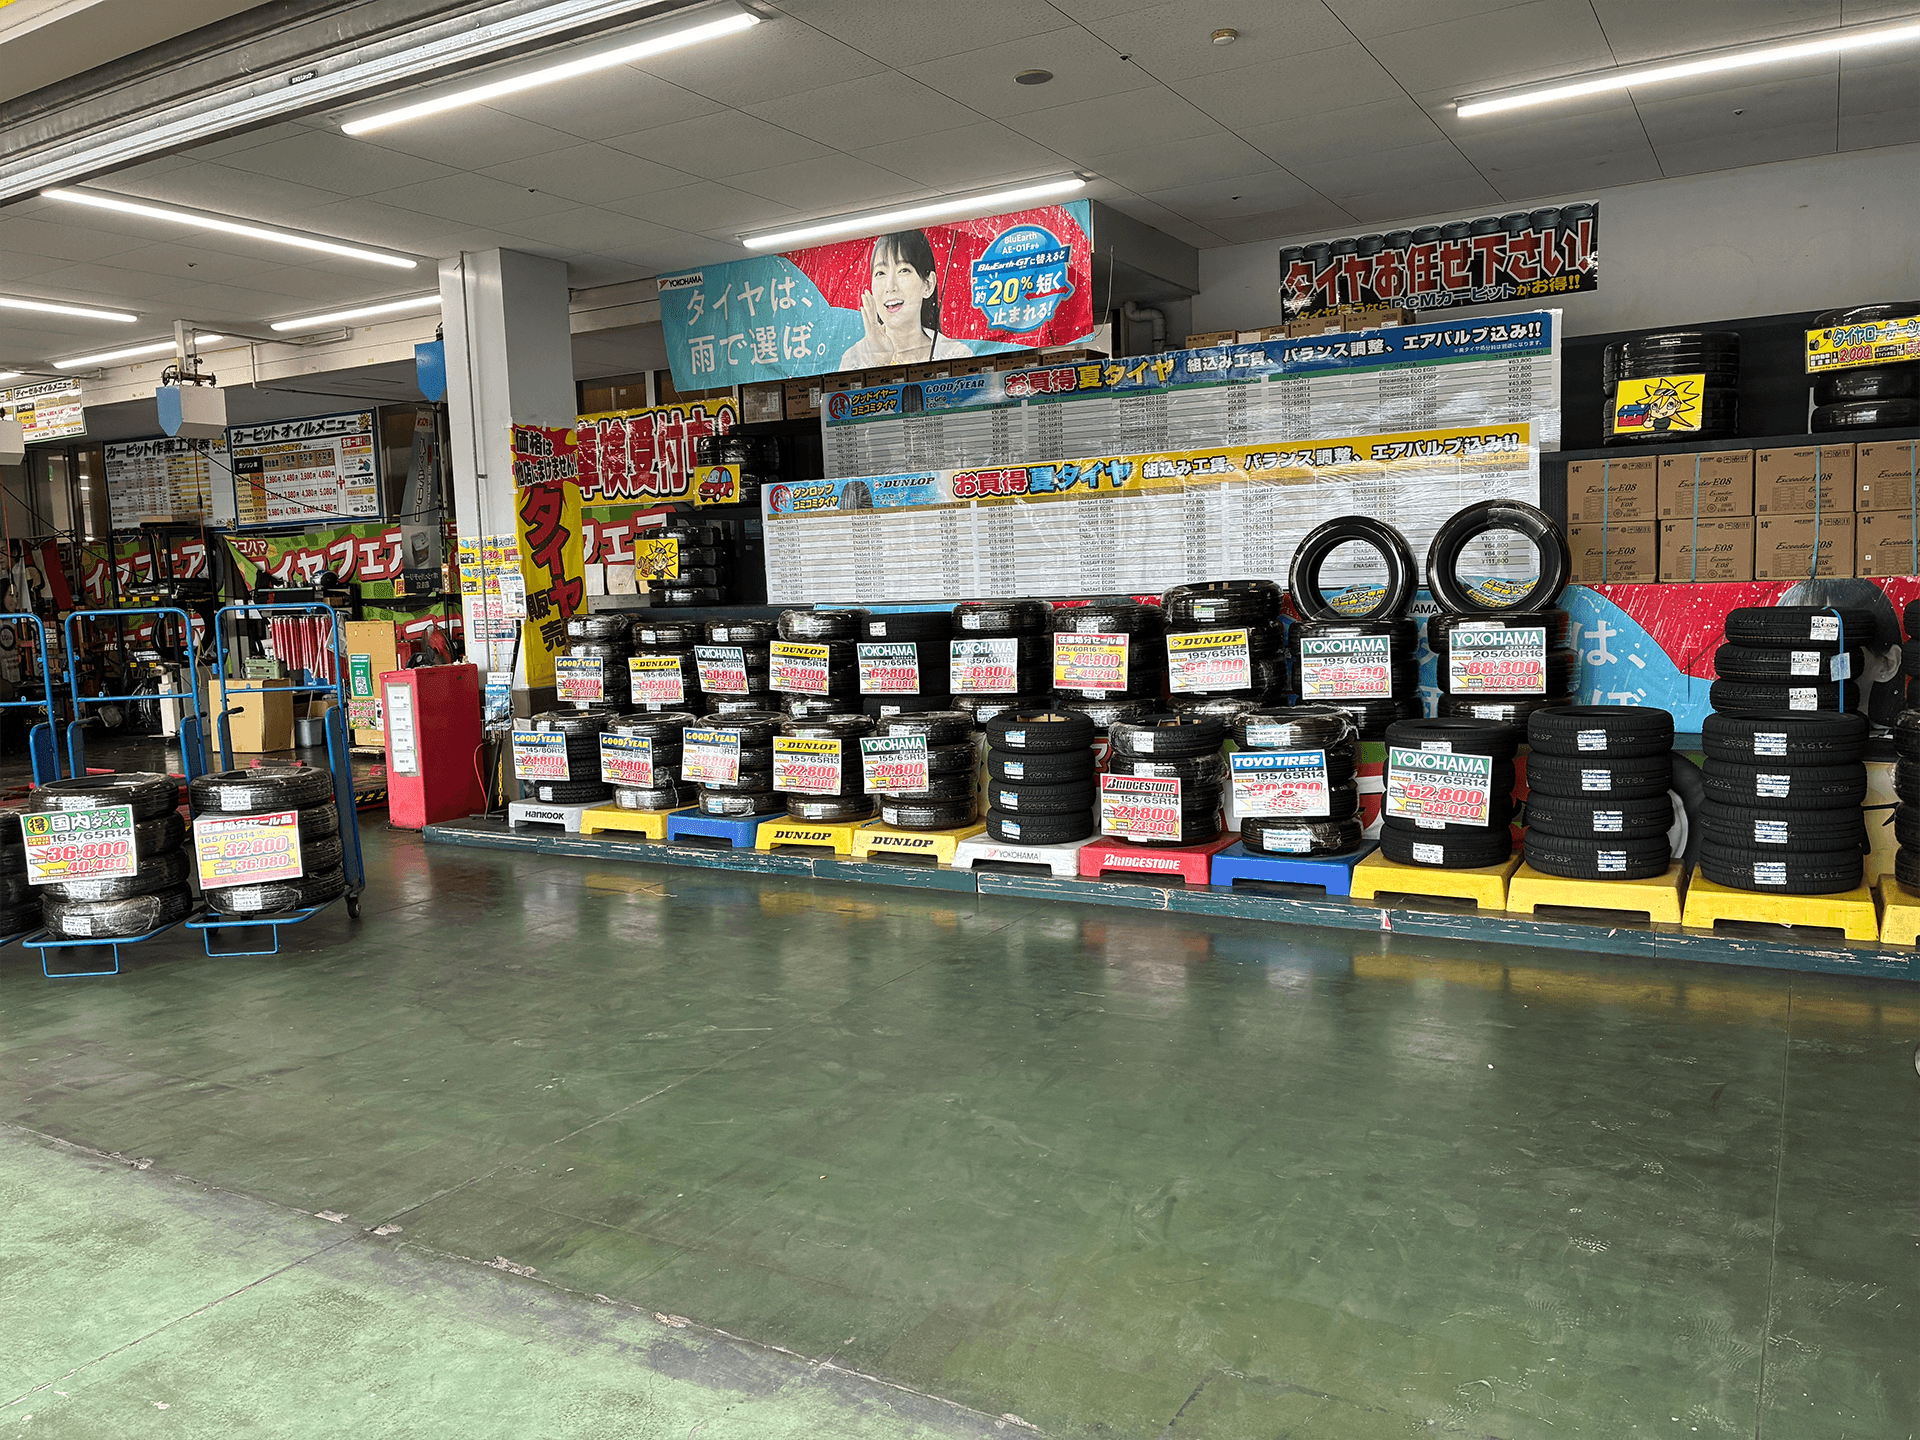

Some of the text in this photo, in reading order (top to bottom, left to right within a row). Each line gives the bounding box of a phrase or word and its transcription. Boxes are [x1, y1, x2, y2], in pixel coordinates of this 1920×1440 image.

[1004, 232, 1037, 244] BluEarth
[669, 275, 702, 288] YOKOHAMA
[687, 276, 812, 326] タイヤは、
[991, 301, 1053, 326] 止まれる!
[688, 321, 826, 375] 雨で選ぼ。
[851, 389, 898, 405] グッドイヤー
[851, 400, 898, 417] コミコミタイヤ
[280, 420, 357, 438] オイルメニュー
[515, 429, 553, 458] 価格は
[515, 454, 579, 488] 他店にまけません!
[884, 477, 935, 489] DUNLOP
[954, 460, 1131, 498] お買得夏タイヤ
[1713, 477, 1732, 486] E08
[793, 484, 834, 499] ダンロップ
[1618, 483, 1637, 492] E08
[793, 496, 839, 510] コミコミタイヤ
[520, 484, 583, 617] タイヤ
[1617, 547, 1636, 555] E08
[1714, 544, 1733, 552] E08
[1411, 604, 1439, 614] AMA
[526, 588, 567, 652] 販売
[1057, 635, 1125, 645] 在庫処分セール品
[1183, 634, 1243, 647] DUNLOP
[1454, 631, 1539, 647] YOKOHAMA
[782, 646, 826, 656] DUNLOP
[860, 645, 914, 656] YOKOHAMA
[953, 641, 1013, 655] YOKOHAMA
[1057, 645, 1097, 653] 175/60R16
[1305, 639, 1385, 654] YOKOHAMA
[697, 648, 741, 660] YOKOHAMA
[1073, 653, 1120, 667] 44,800
[1188, 650, 1248, 660] 195/65R15
[1472, 649, 1544, 659] 205/60R16
[639, 660, 677, 668] DUNLOP
[784, 658, 827, 668] 185/65R14
[873, 659, 917, 667] 175/65R15
[1322, 656, 1389, 666] 195/60R16
[706, 669, 744, 680] 50,800
[780, 666, 825, 680] 58,800
[871, 667, 915, 679] 62,800
[1468, 661, 1539, 676] 88,800
[1484, 675, 1539, 688] 97,680
[697, 745, 738, 755] 145/80R13
[787, 741, 837, 750] DUNLOP
[864, 737, 924, 752] YOKOHAMA
[524, 755, 564, 766] 21,800
[790, 755, 840, 765] 155/65R13
[878, 753, 926, 762] 155/65R13
[1234, 754, 1321, 767] TOYO TIRES
[1394, 750, 1486, 774] YOKOHAMA
[785, 764, 837, 778] 22,800
[876, 763, 924, 777] 37,800
[1255, 771, 1325, 780] 155/65R14
[1106, 777, 1176, 793] BRIDGESTONE
[1412, 772, 1489, 787] 155/65R14
[1406, 783, 1483, 804] 52,800
[1120, 795, 1179, 806] 155/65R14
[91, 809, 127, 818] メーカー
[1116, 805, 1175, 821] 21,800
[1423, 801, 1482, 818] 58,080
[50, 812, 92, 832] 国内
[90, 816, 126, 828] タイヤ
[1130, 820, 1174, 833] 23,980
[51, 829, 132, 843] 165/65R14
[200, 831, 255, 844] 165/70R14
[774, 830, 832, 841] DUNLOP
[871, 835, 934, 848] DUNLOP
[48, 840, 128, 862] 36,800
[224, 835, 289, 859] 32,800
[998, 850, 1039, 861] YOKOHAMA
[1102, 853, 1181, 870] BRIDGESTONE
[67, 856, 127, 873] 40,480
